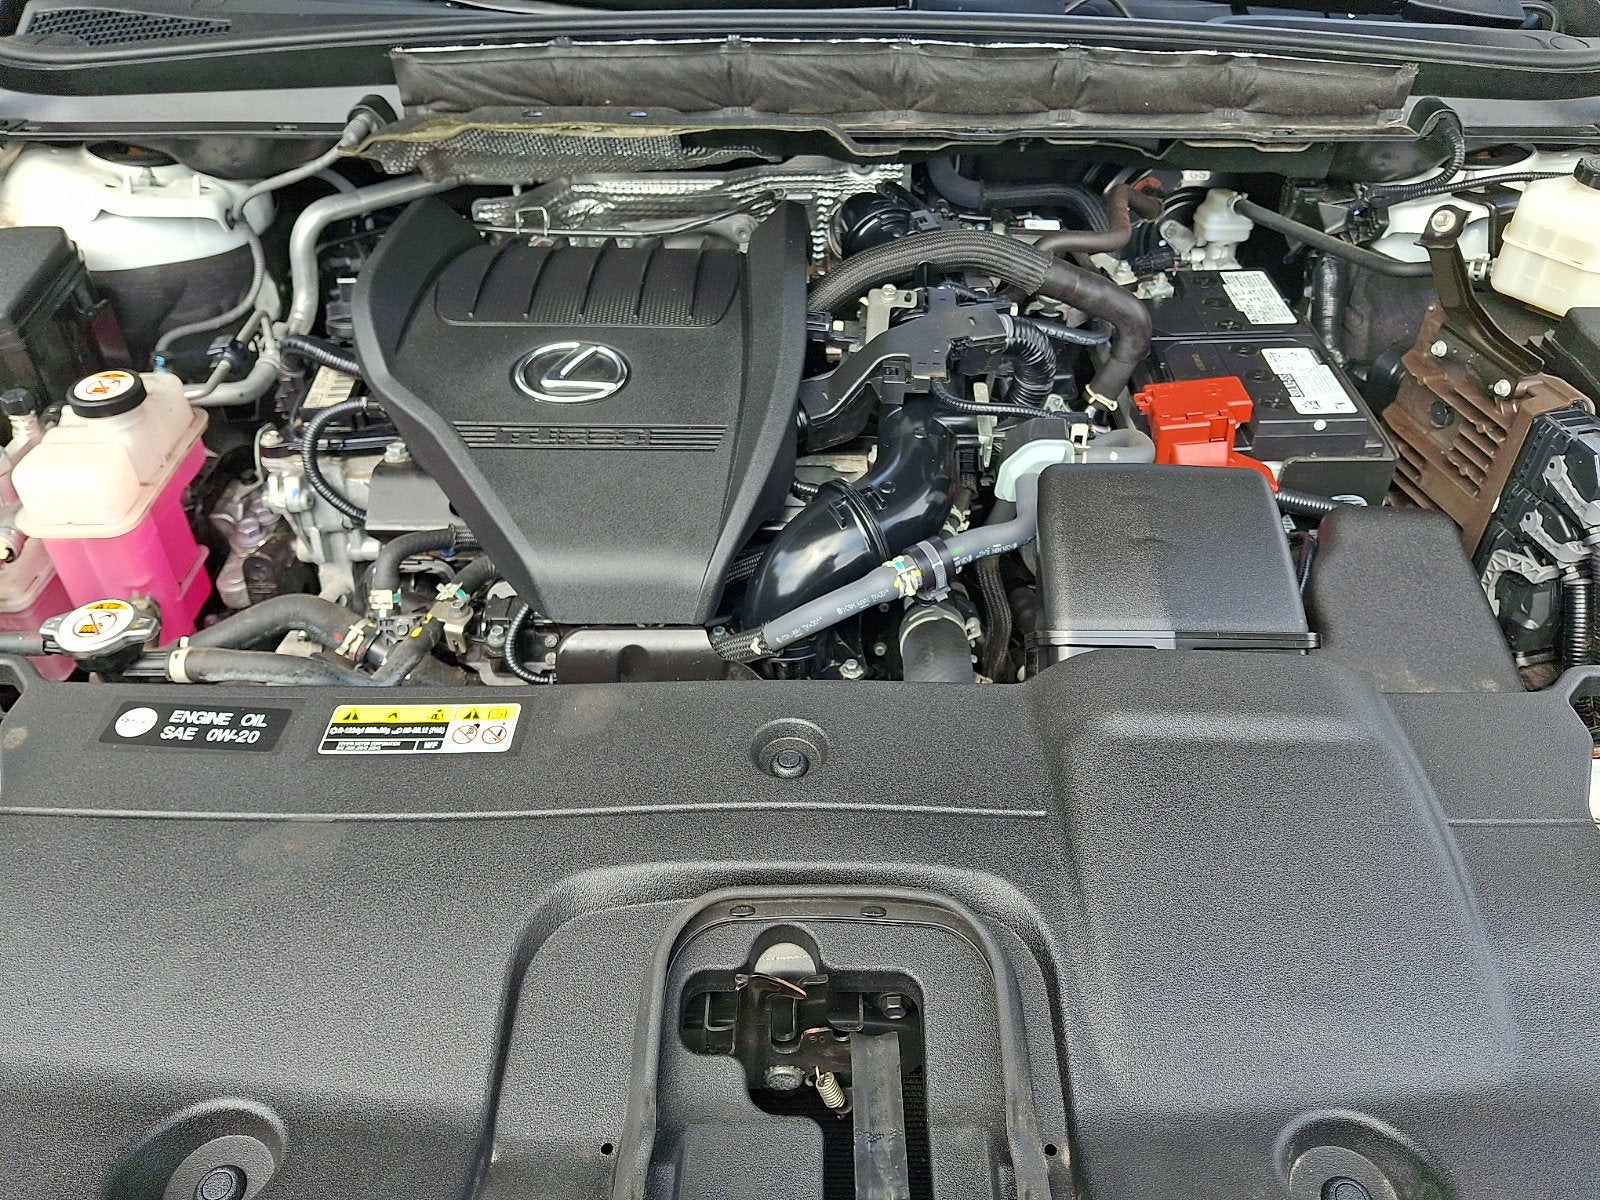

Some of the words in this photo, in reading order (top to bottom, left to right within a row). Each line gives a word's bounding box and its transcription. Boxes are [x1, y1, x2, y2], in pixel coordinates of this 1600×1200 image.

[500, 426, 647, 445] TURBO
[169, 709, 234, 726] ENGINE
[240, 713, 268, 728] OIL
[160, 725, 199, 741] SAE
[205, 728, 261, 744] 0W-20
